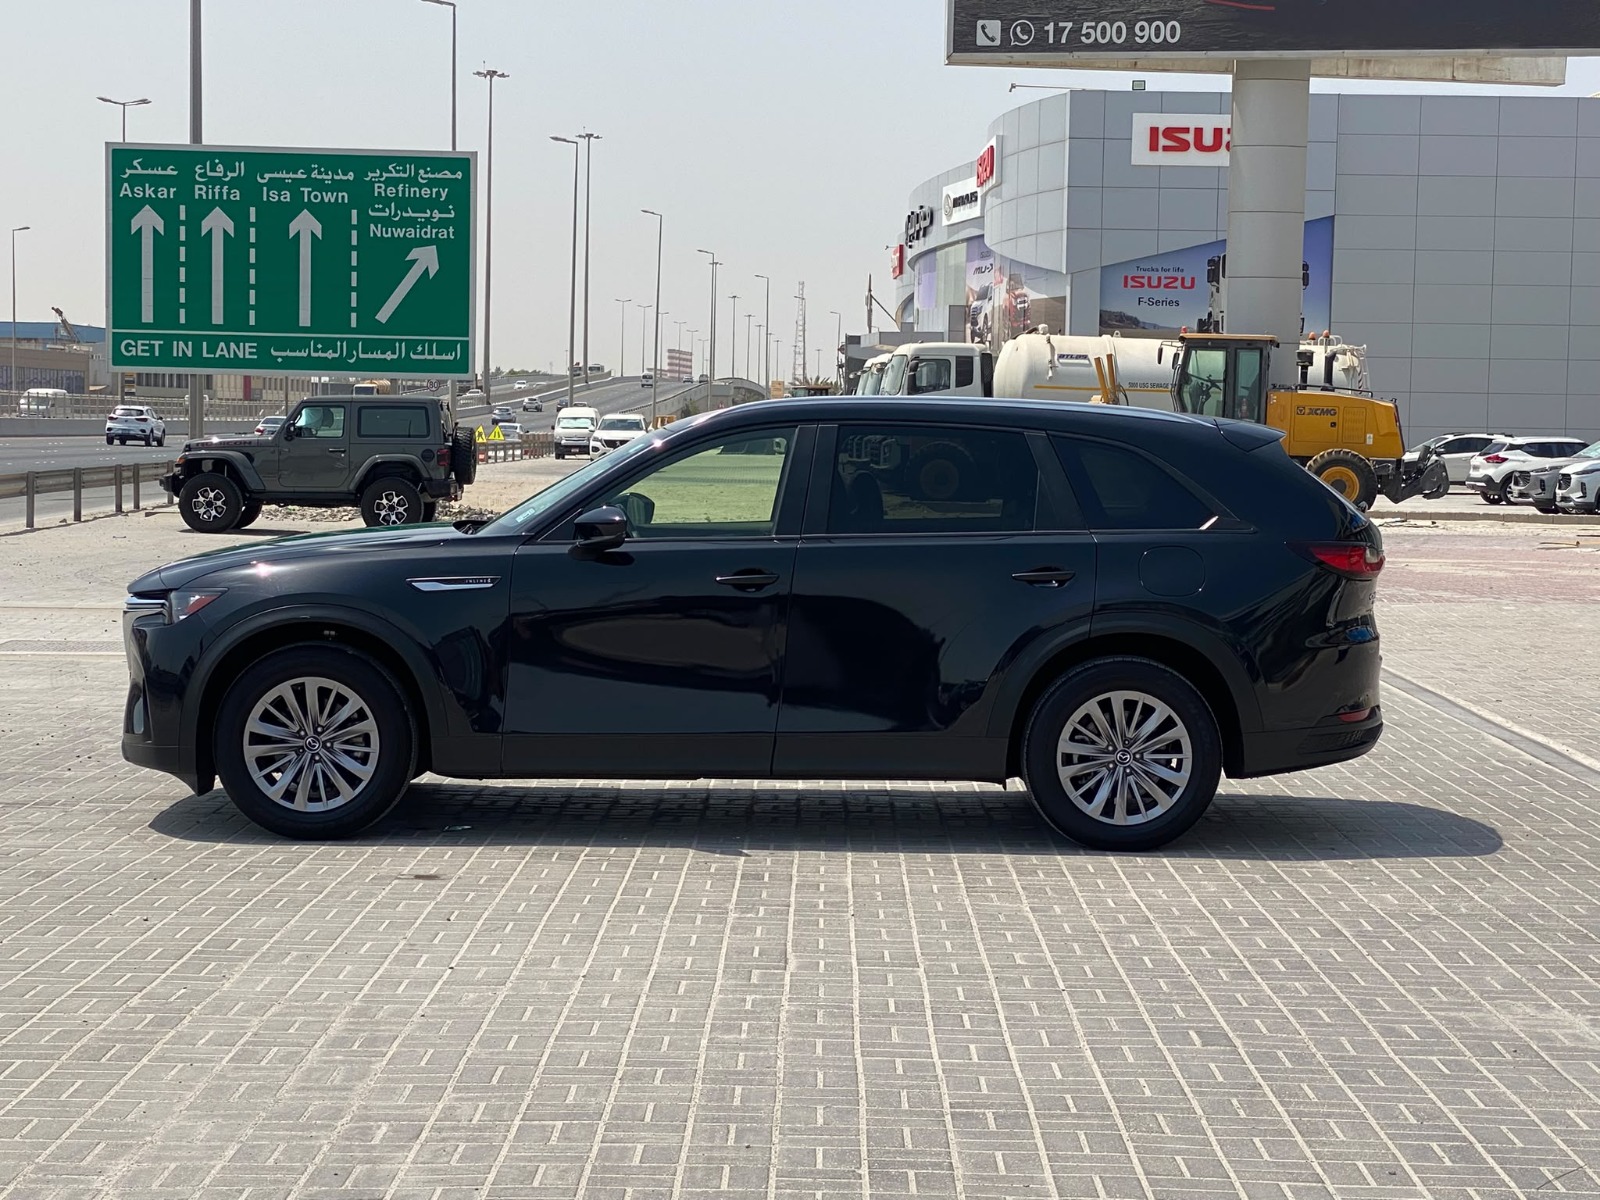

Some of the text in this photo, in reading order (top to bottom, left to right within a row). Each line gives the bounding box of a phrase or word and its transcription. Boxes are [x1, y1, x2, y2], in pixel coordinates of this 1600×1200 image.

[1044, 20, 1181, 44] 17 500 900
[120, 158, 178, 178] عسكر
[195, 159, 245, 181] الرفاع
[256, 164, 354, 184] مدينة عيسى
[363, 163, 462, 183] مصنع التكرير
[119, 182, 177, 198] Askar
[194, 184, 240, 200] Riffa
[262, 186, 348, 203] Isa Town
[374, 183, 448, 201] Refinery
[368, 201, 455, 222] نويدرات
[370, 223, 454, 239] Nuwaidrat
[1123, 275, 1195, 289] ISUZU
[1138, 297, 1180, 307] F-Series
[120, 339, 258, 359] GET IN LANE
[270, 340, 461, 363] اسلك المسار المناسب
[1306, 407, 1337, 416] XCMG
